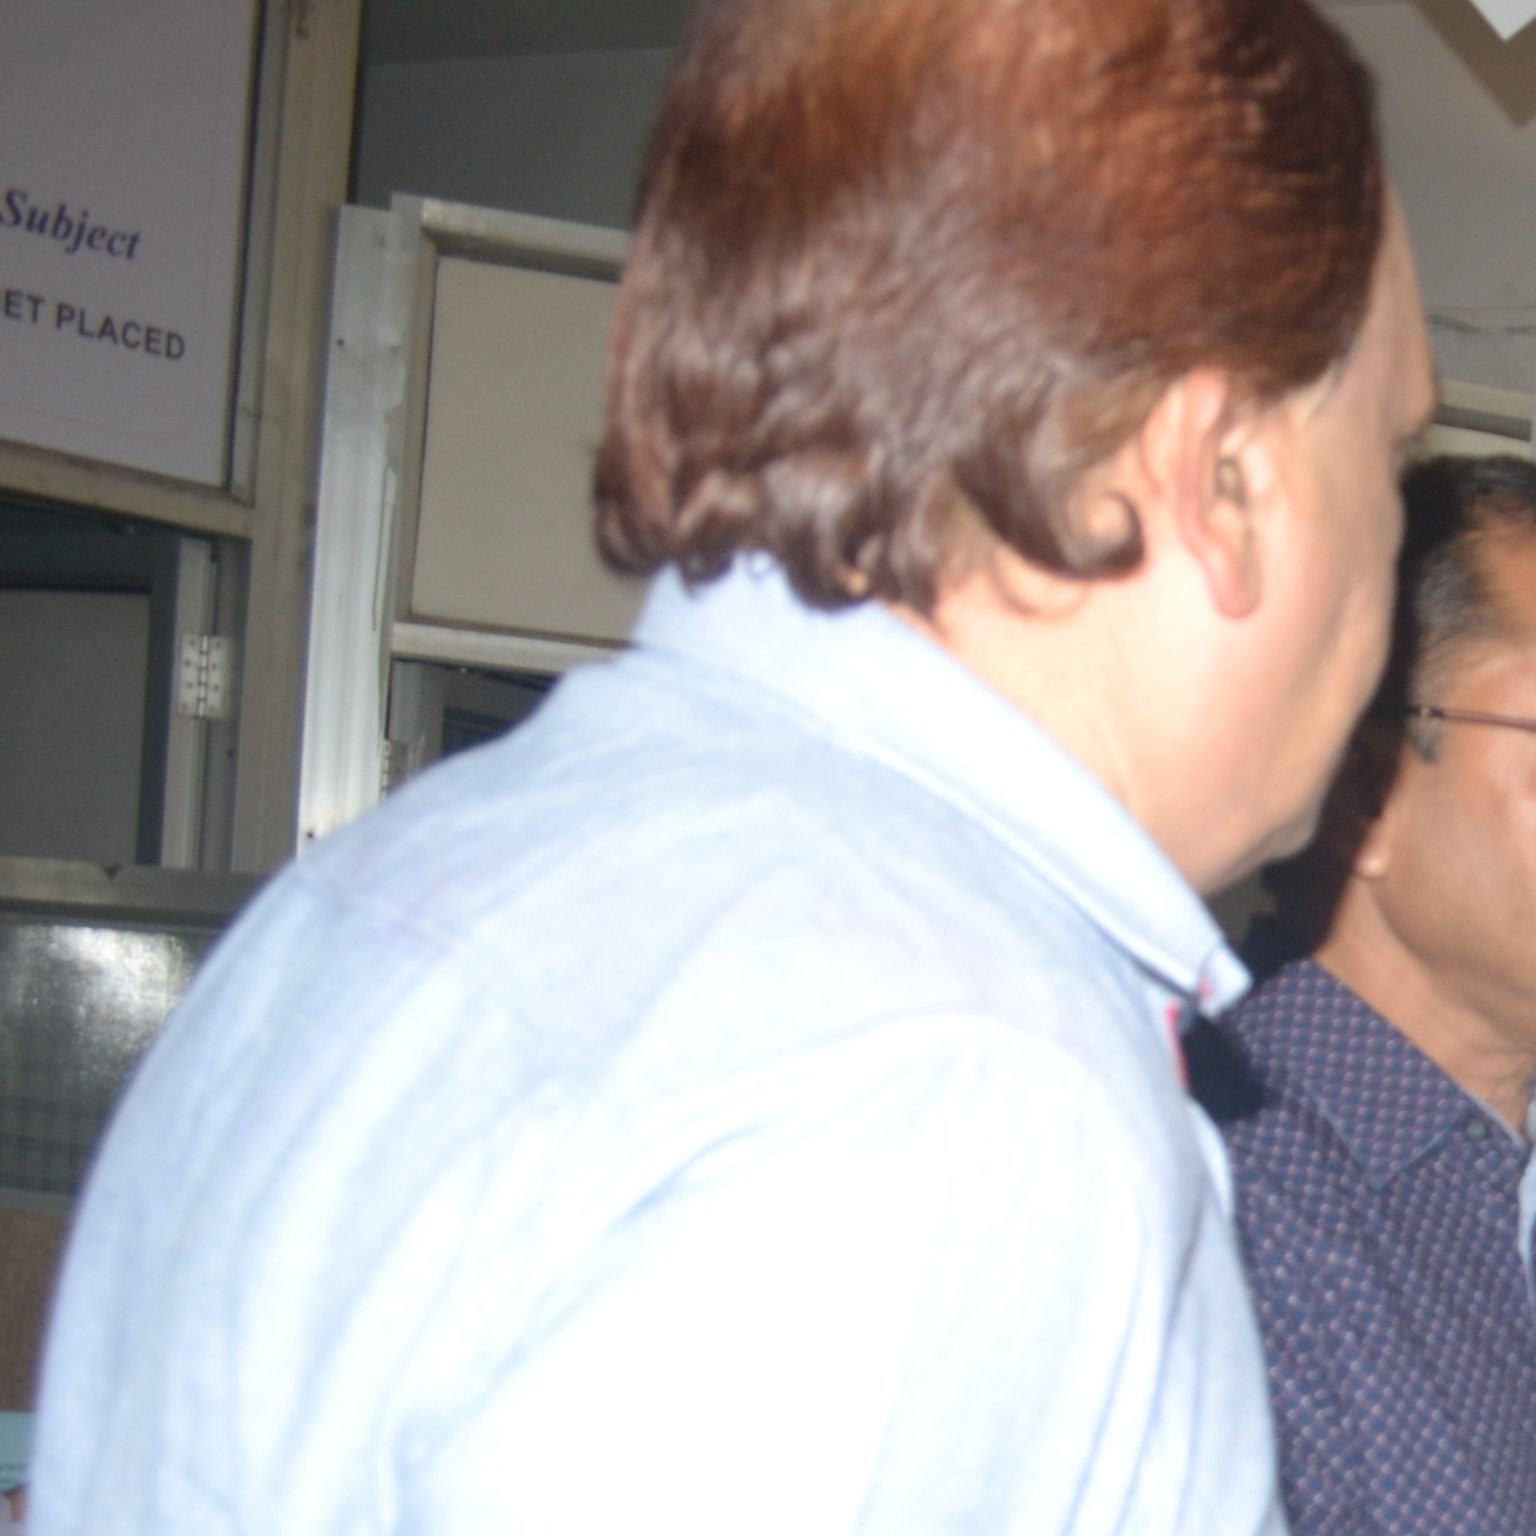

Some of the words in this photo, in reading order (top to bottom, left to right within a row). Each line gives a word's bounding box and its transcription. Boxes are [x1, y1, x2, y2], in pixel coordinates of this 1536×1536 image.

[0, 188, 142, 261] Subject
[0, 288, 46, 325] ET
[56, 302, 186, 361] PLACED
